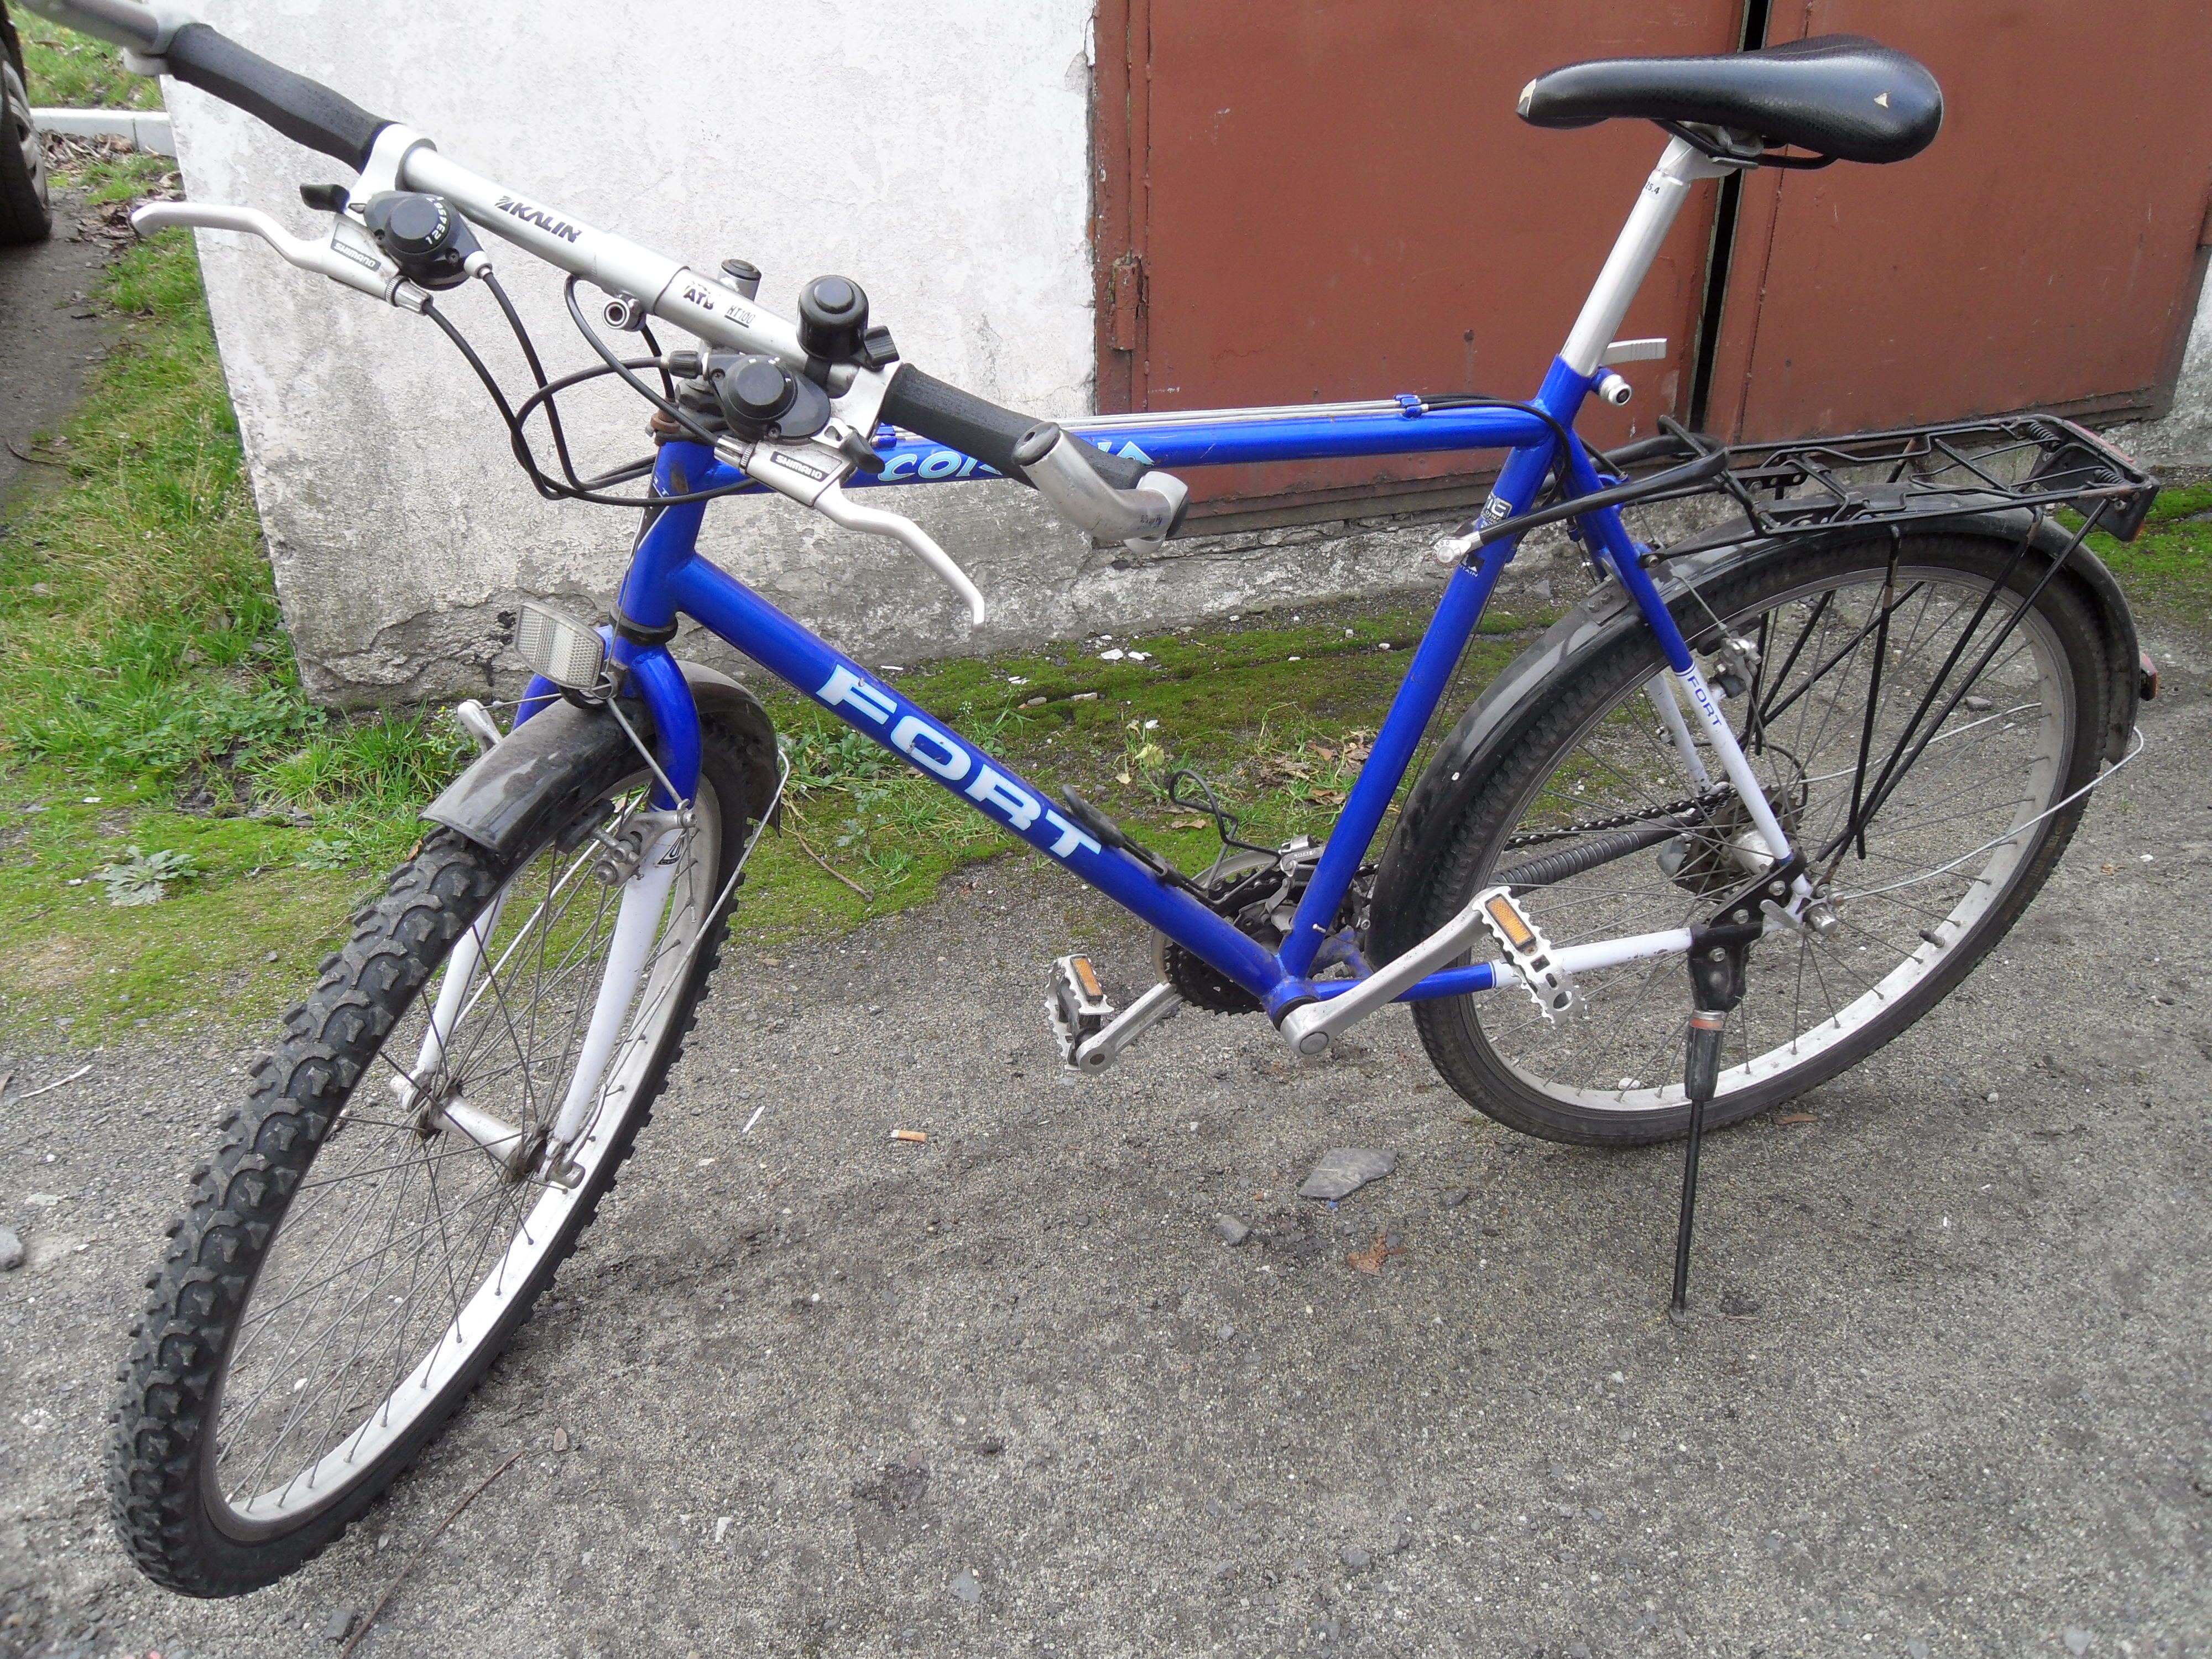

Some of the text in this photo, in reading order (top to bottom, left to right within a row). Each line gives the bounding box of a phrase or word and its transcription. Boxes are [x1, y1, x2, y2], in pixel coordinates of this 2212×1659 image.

[334, 242, 376, 268] SHIMANO
[775, 455, 823, 480] SHIMANO
[1687, 675, 1723, 726] FORT
[816, 664, 1102, 859] FORT
